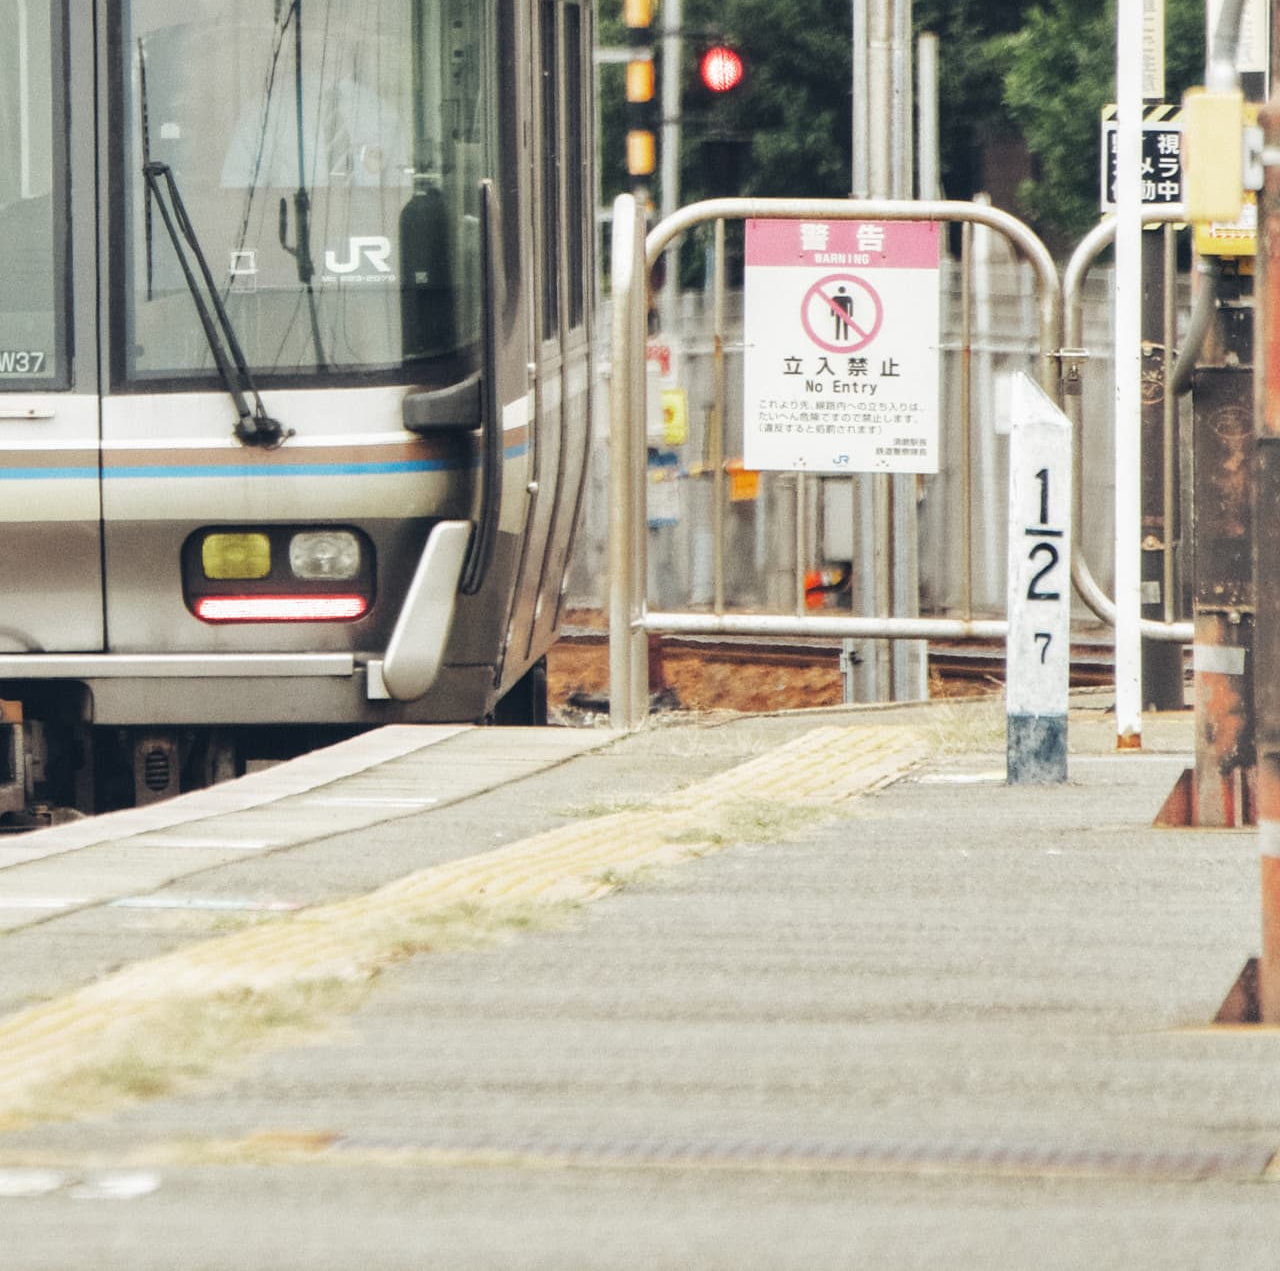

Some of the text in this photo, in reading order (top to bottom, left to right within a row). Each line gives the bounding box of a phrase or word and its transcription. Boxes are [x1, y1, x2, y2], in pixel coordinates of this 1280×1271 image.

[798, 222, 887, 253] 警告
[325, 236, 392, 274] JR
[813, 253, 870, 266] WARNING
[783, 355, 901, 378] 立入禁止
[805, 379, 878, 396] No Entry
[832, 454, 851, 465] JR
[1034, 466, 1050, 526] 1
[1026, 541, 1061, 602] 2
[1033, 632, 1053, 666] 7
